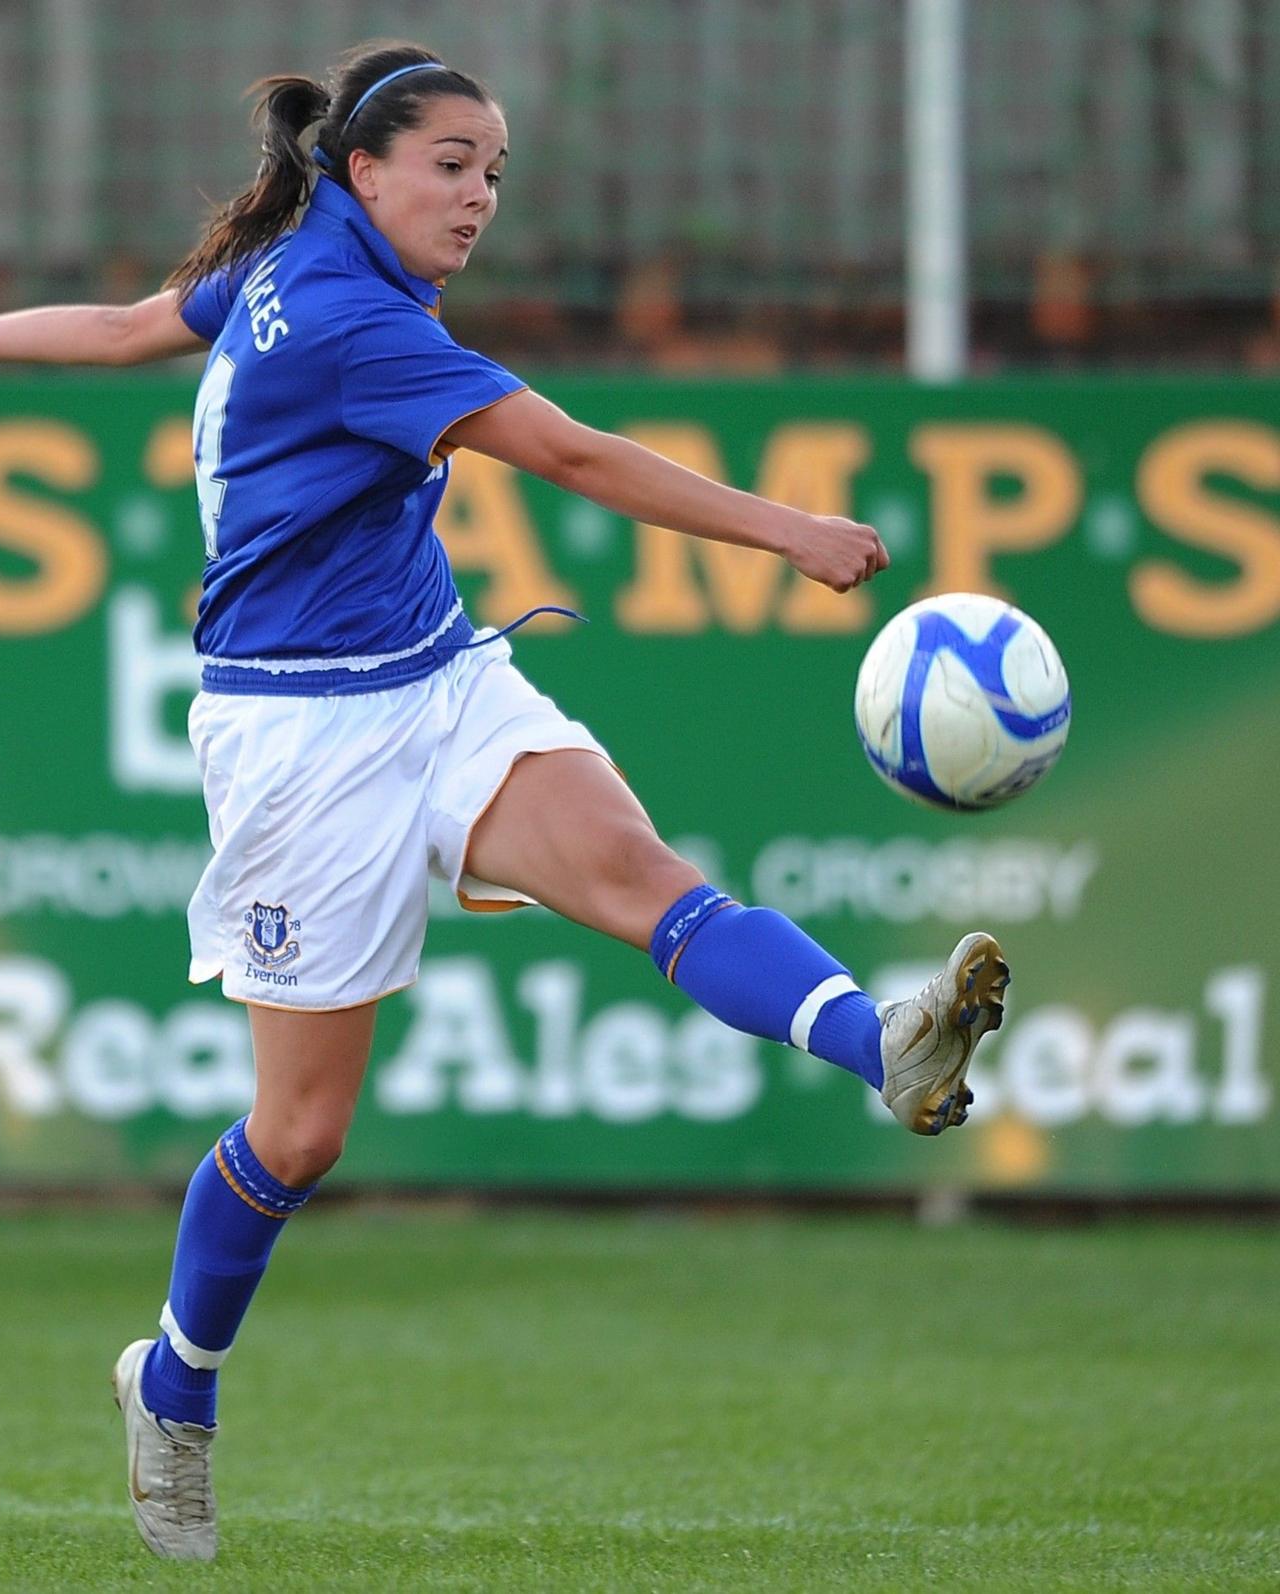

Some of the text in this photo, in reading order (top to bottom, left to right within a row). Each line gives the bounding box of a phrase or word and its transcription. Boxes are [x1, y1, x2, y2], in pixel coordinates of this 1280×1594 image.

[753, 835, 1098, 922] CROSBY
[245, 962, 298, 986] Everton
[375, 957, 762, 1120] Ales
